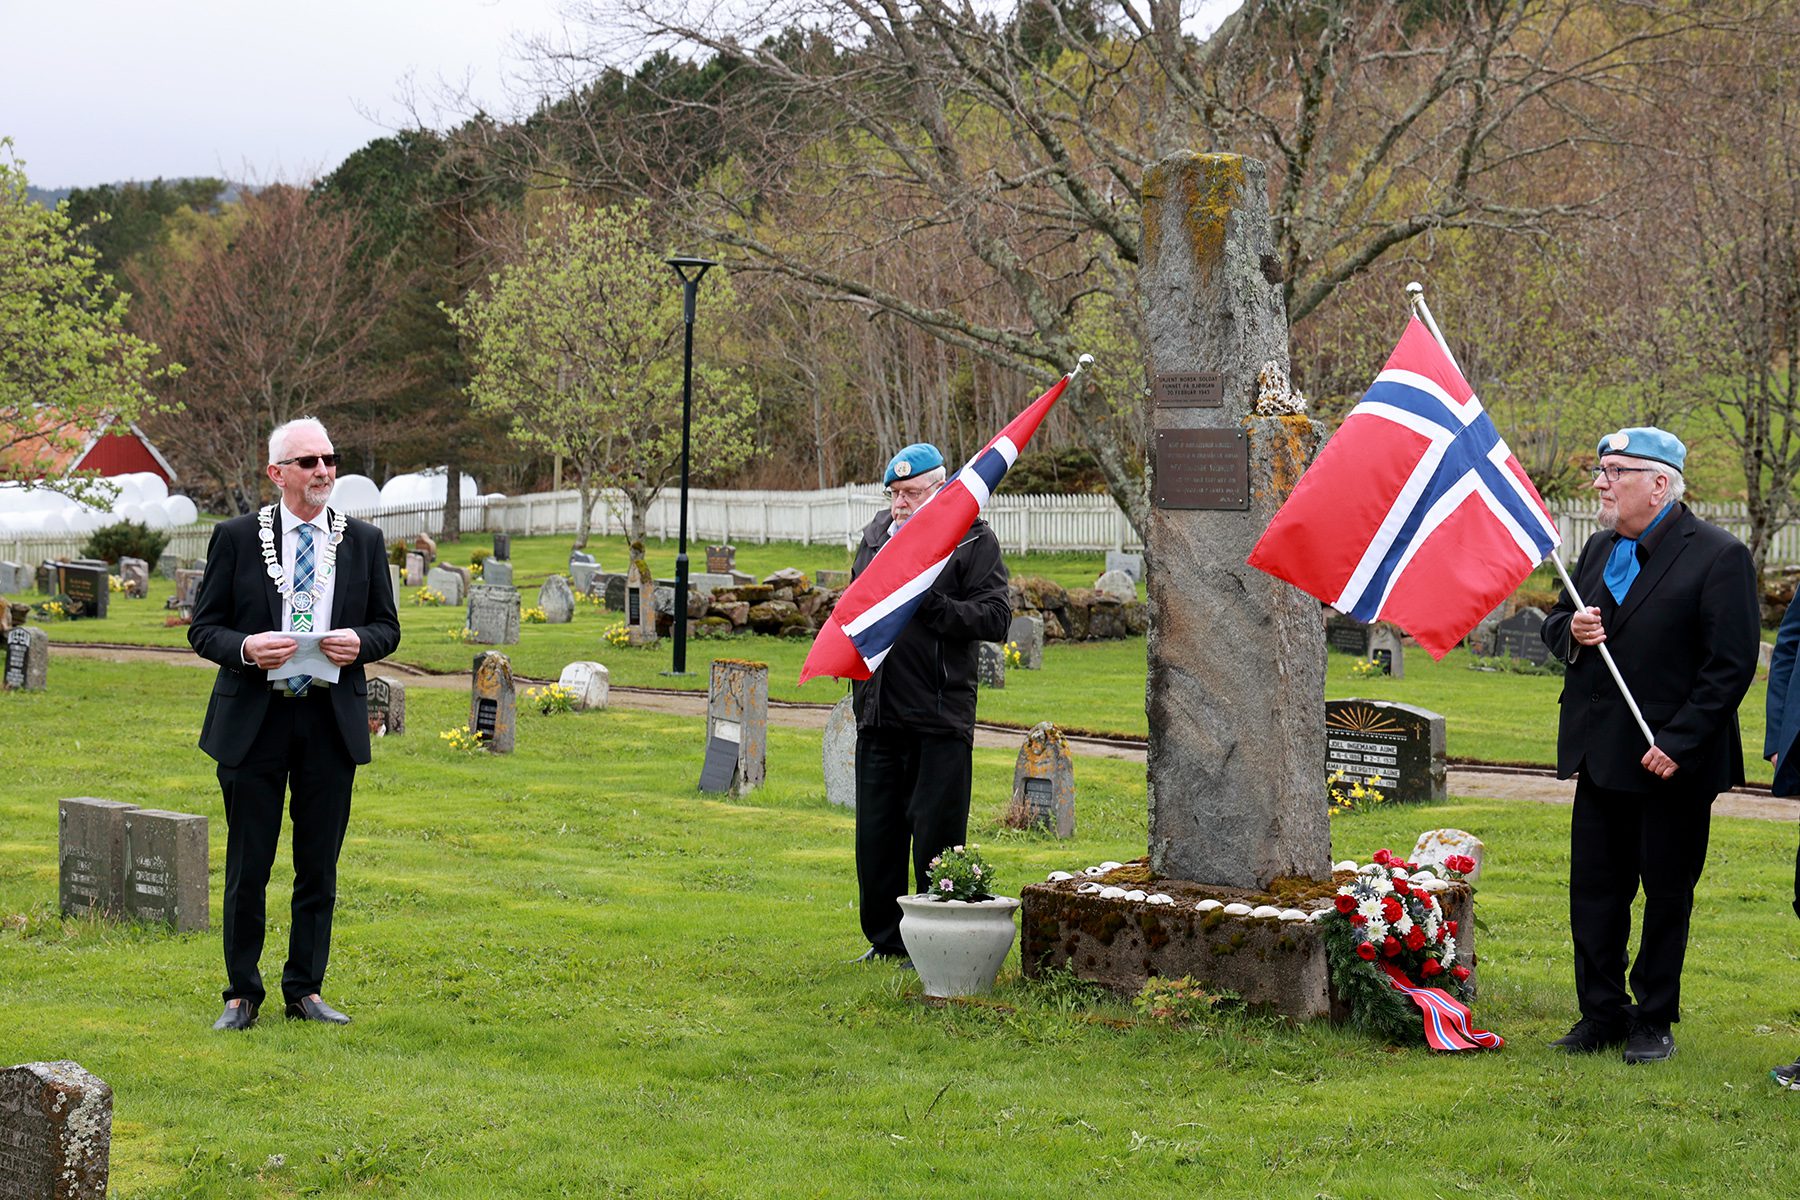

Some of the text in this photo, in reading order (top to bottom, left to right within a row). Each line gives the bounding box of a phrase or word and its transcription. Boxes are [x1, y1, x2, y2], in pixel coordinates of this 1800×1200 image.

[1347, 742, 1377, 751] INGEMAND
[1380, 745, 1396, 753] AUNE
[1383, 768, 1398, 776] AUNE
